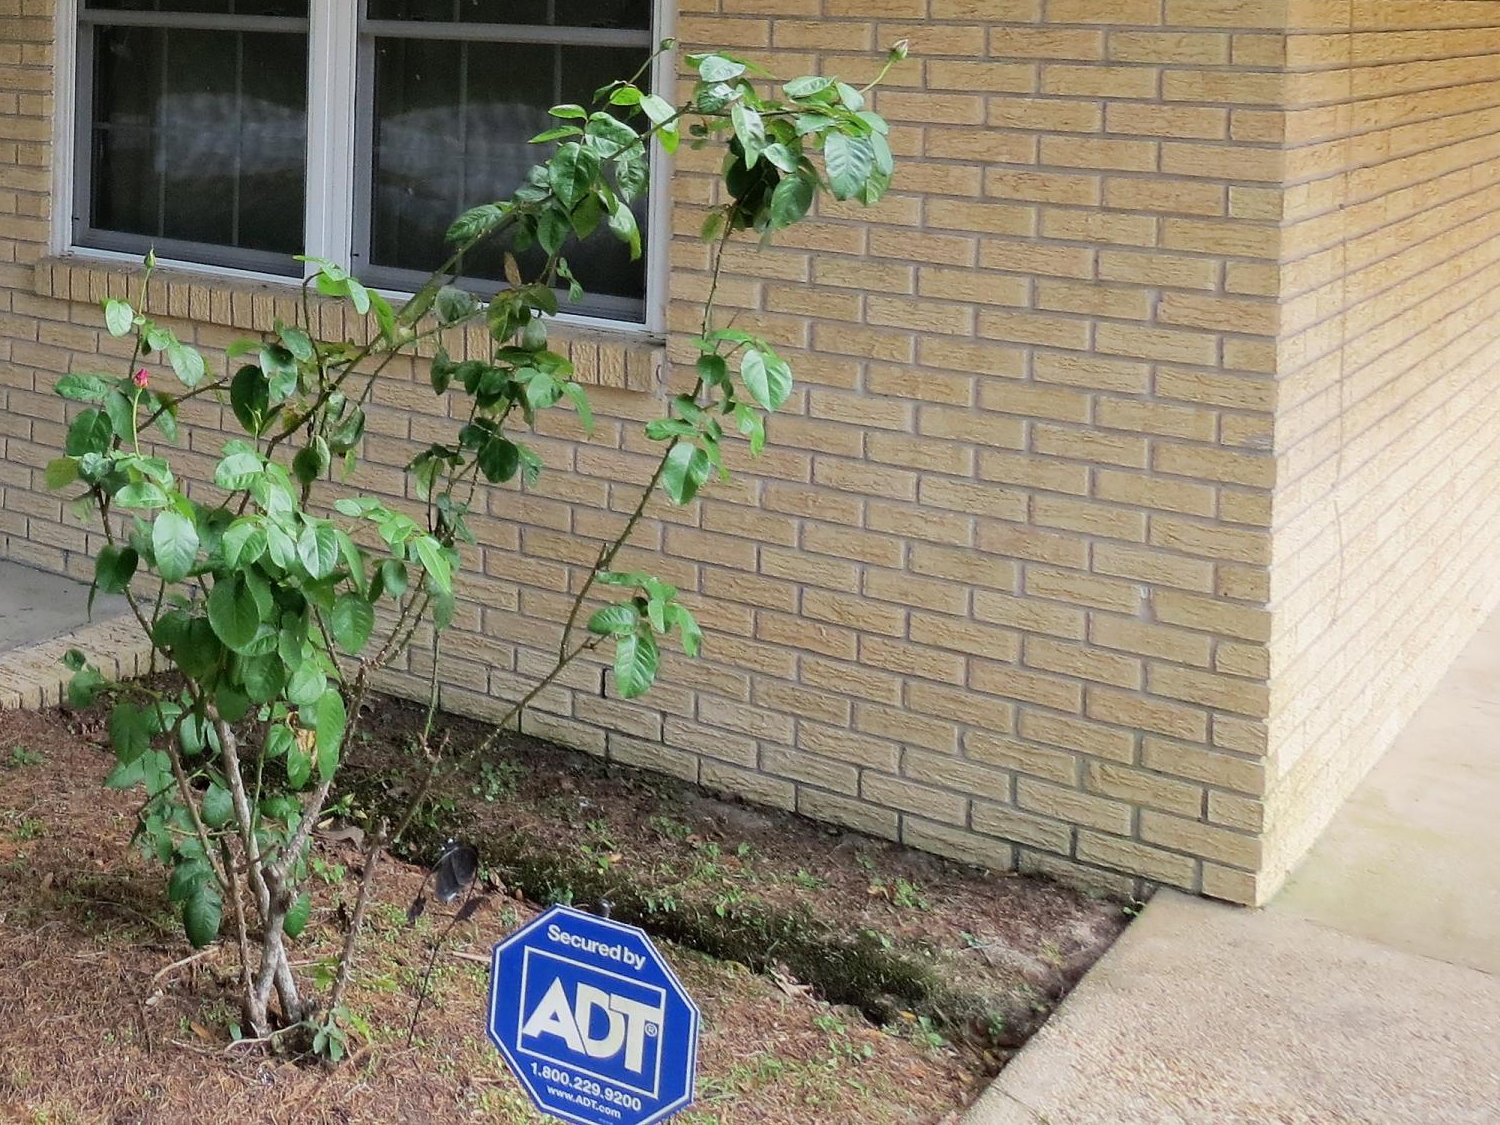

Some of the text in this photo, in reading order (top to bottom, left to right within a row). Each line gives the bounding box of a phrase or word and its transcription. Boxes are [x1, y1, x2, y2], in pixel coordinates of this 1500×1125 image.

[547, 924, 646, 971] Secured by
[522, 976, 662, 1074] ADT
[531, 1062, 642, 1111] 1.800.229.9200
[546, 1086, 622, 1120] www.ADT.com
